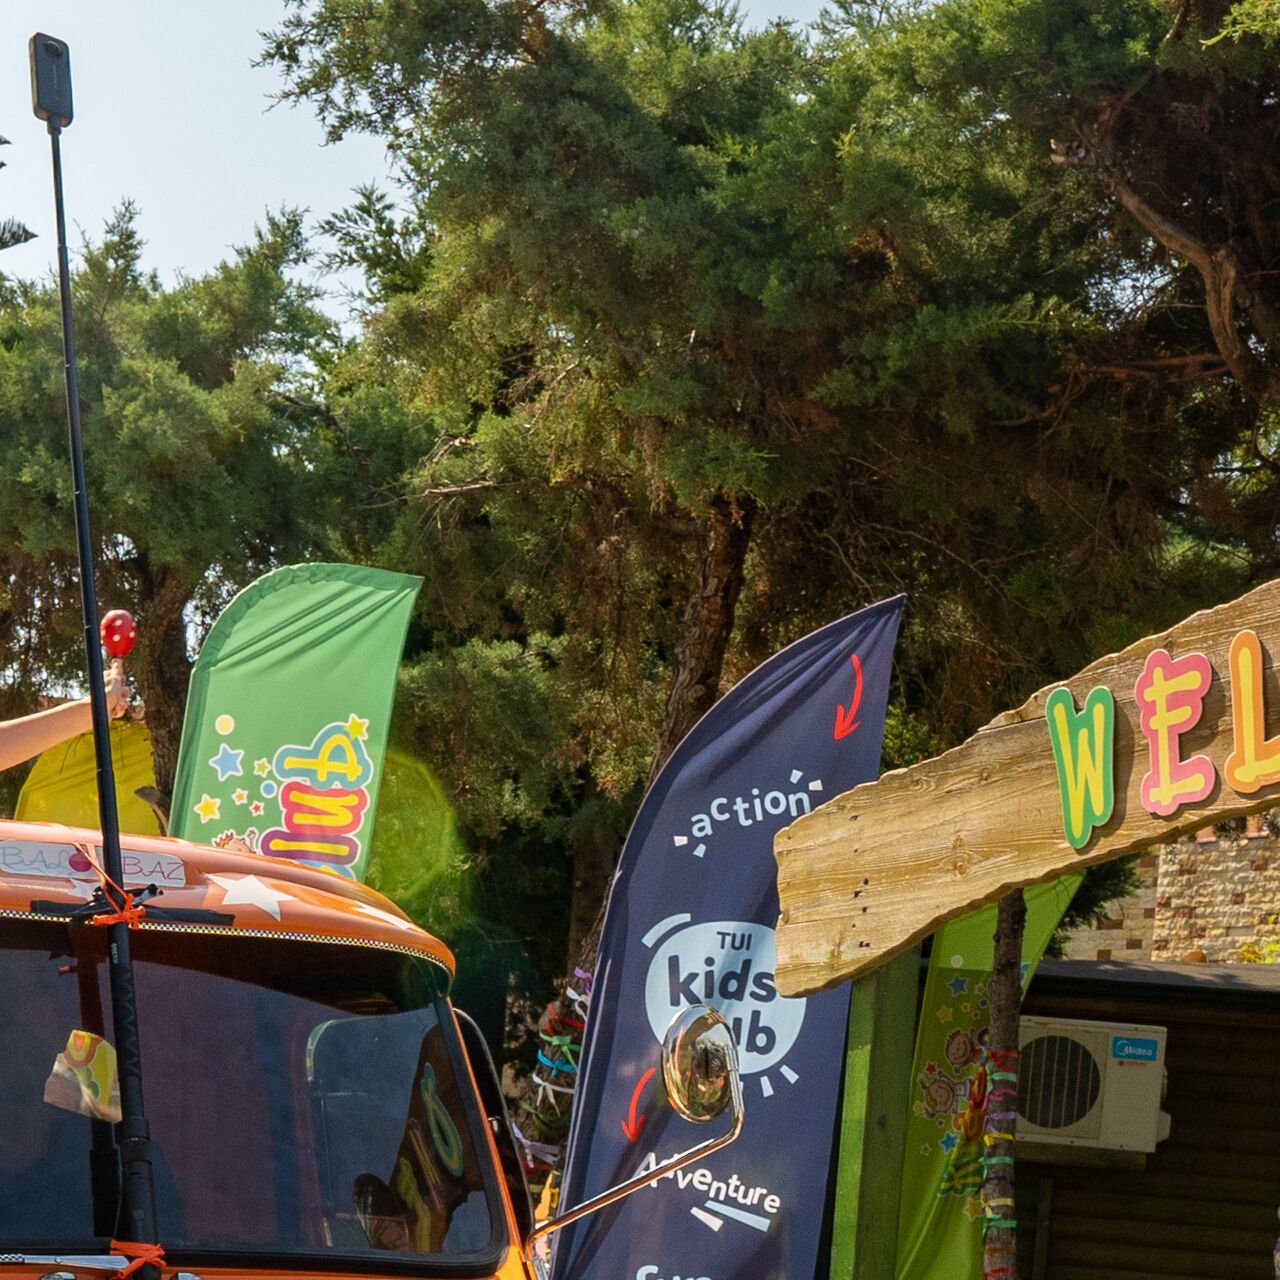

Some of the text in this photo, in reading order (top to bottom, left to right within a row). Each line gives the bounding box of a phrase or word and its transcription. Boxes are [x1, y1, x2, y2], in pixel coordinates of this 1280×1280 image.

[691, 787, 812, 839] action
[716, 931, 753, 951] TUI
[668, 955, 776, 1007] kids
